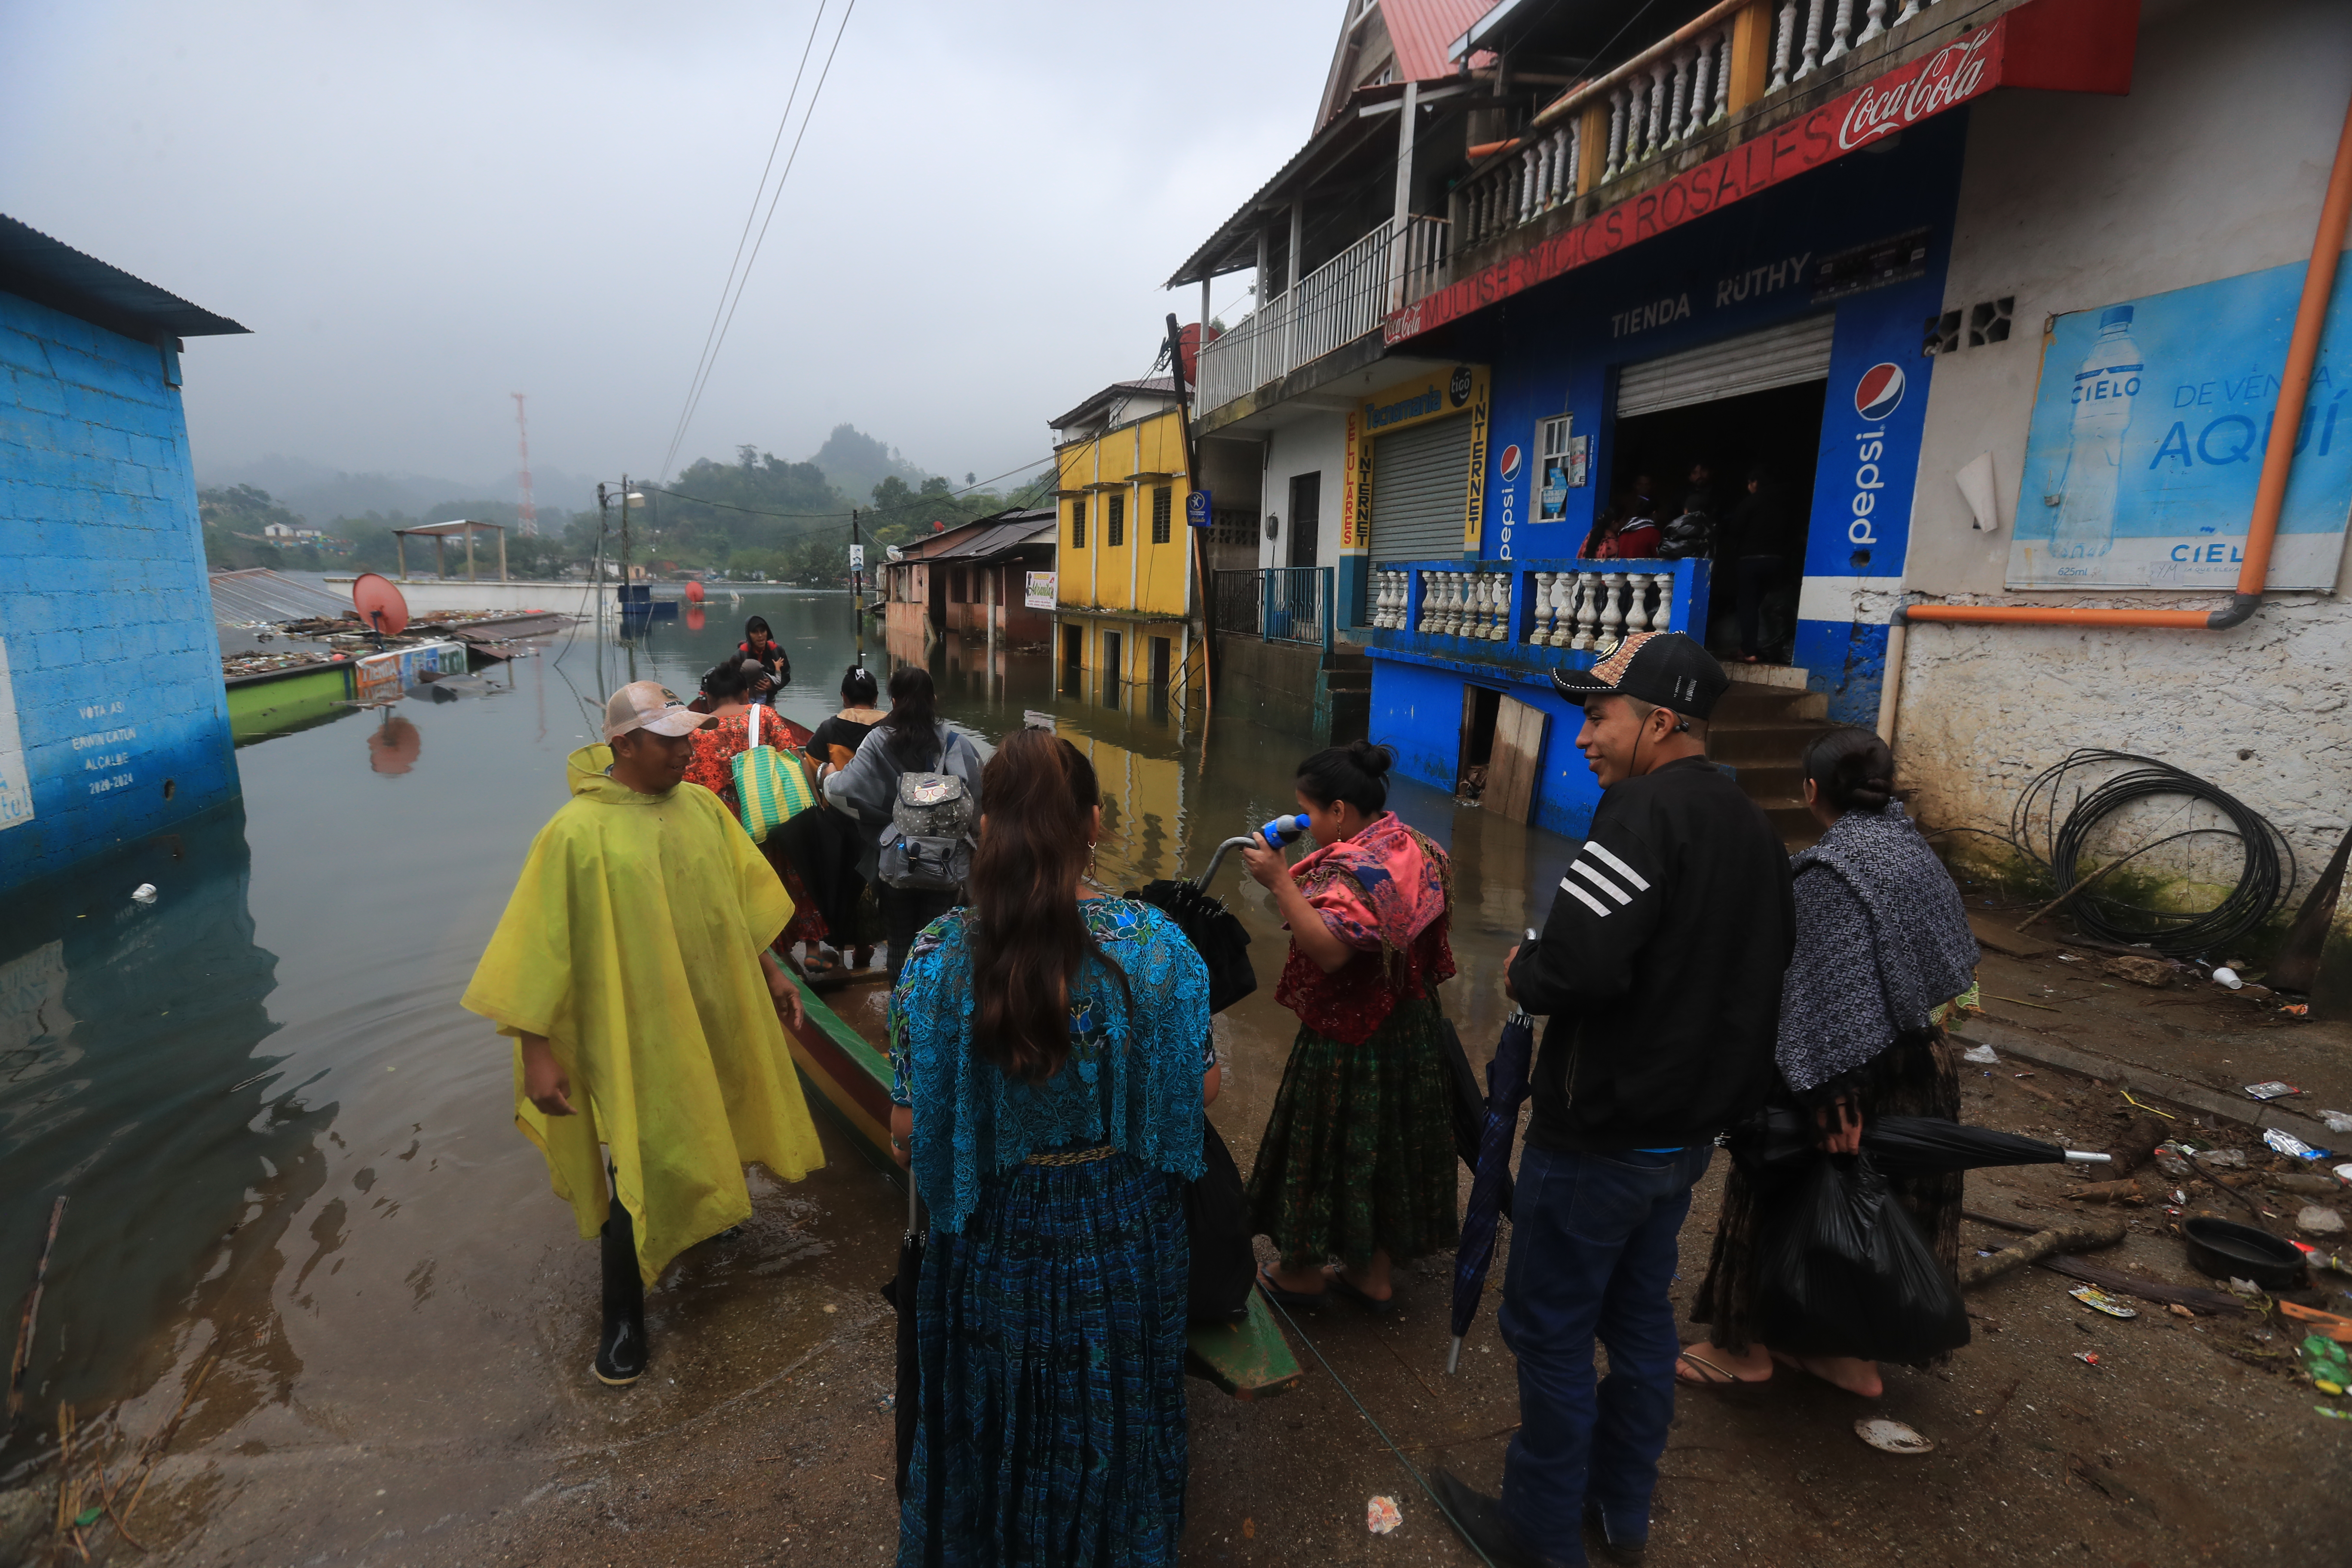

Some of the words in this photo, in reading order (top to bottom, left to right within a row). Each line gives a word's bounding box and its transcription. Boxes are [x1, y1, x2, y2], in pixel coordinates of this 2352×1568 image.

[1384, 303, 1422, 345] Coca-Cola
[1635, 109, 1832, 243] ROSALES
[1838, 21, 1999, 150] Coca-Cola
[1612, 293, 1690, 339] TIENDA
[1716, 252, 1811, 307] RUTHY
[1366, 385, 1442, 430] Tecnomania
[2071, 377, 2141, 404] CIELO
[2174, 382, 2216, 408] DE
[2225, 365, 2332, 402] VENA
[1344, 411, 1356, 545] CELULARES
[1468, 383, 1486, 534] INTERNET
[1357, 445, 1372, 547] INTERNET
[1848, 430, 1885, 544] pepsi
[1500, 487, 1516, 561] pepsi
[2058, 567, 2088, 576] 625ml
[2171, 543, 2244, 563] CIEL
[362, 658, 397, 682] TIENDA
[79, 705, 106, 719] VOTA
[86, 752, 128, 770] ALCALDE
[89, 773, 134, 795] 2020-2024
